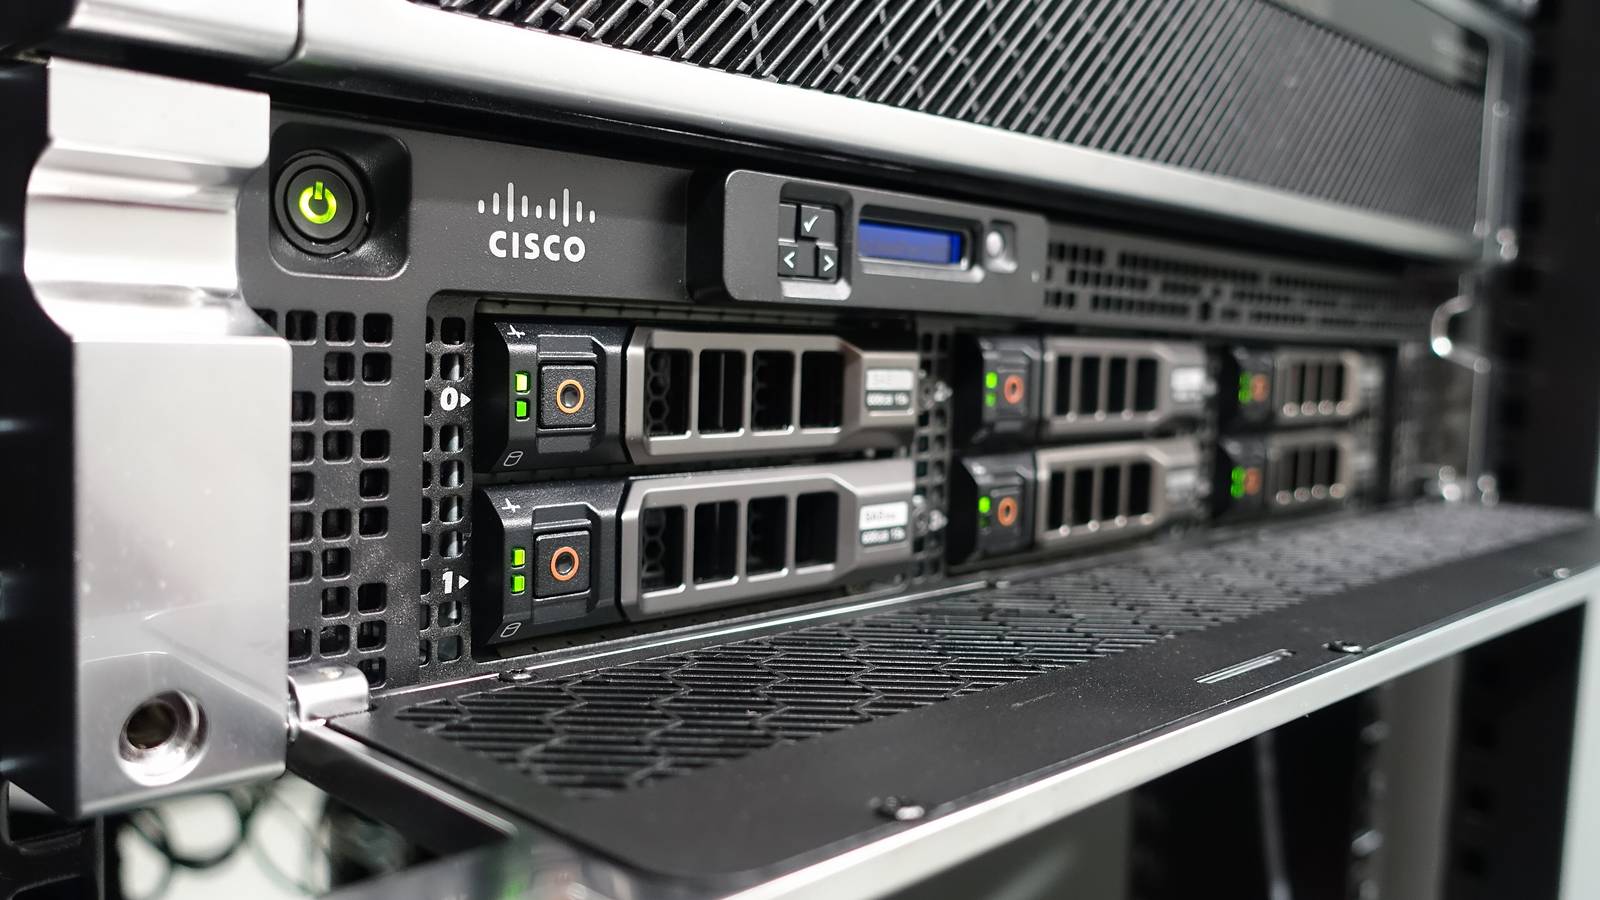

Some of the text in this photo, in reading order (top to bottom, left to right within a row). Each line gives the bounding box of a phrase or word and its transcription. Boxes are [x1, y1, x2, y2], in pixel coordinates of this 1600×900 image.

[489, 230, 586, 263] CISCO
[440, 387, 459, 411] 0
[442, 570, 454, 594] 1
